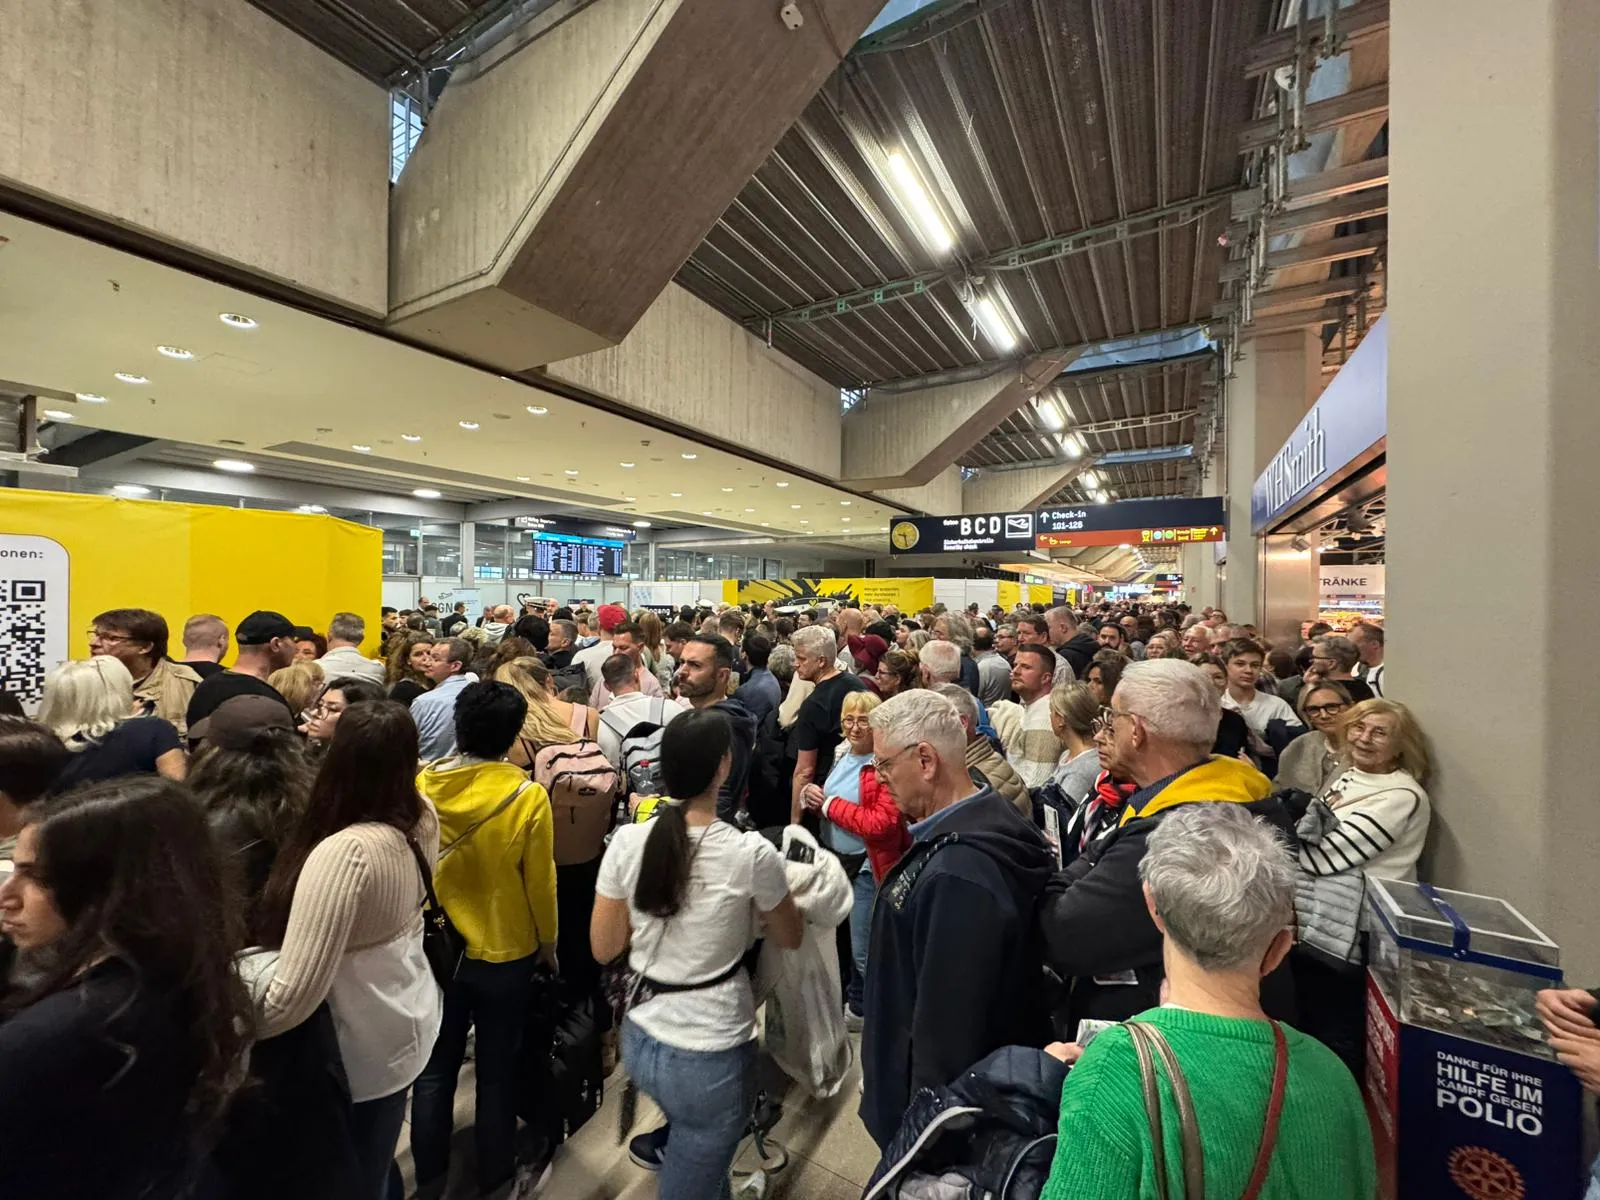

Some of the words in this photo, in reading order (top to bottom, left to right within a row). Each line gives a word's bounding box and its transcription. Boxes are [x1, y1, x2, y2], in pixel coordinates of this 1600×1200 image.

[1265, 407, 1327, 518] WHSmith
[1052, 510, 1087, 519] Check-in
[1436, 1050, 1480, 1070] DANKE
[1482, 1063, 1509, 1078] FÜR
[1511, 1072, 1543, 1087] IHRE
[1436, 1061, 1507, 1095] HILFE
[1514, 1083, 1543, 1105] IM
[1436, 1077, 1486, 1098] KAMPF
[1489, 1093, 1543, 1116] GEGEN
[1436, 1087, 1543, 1136] POLIO
